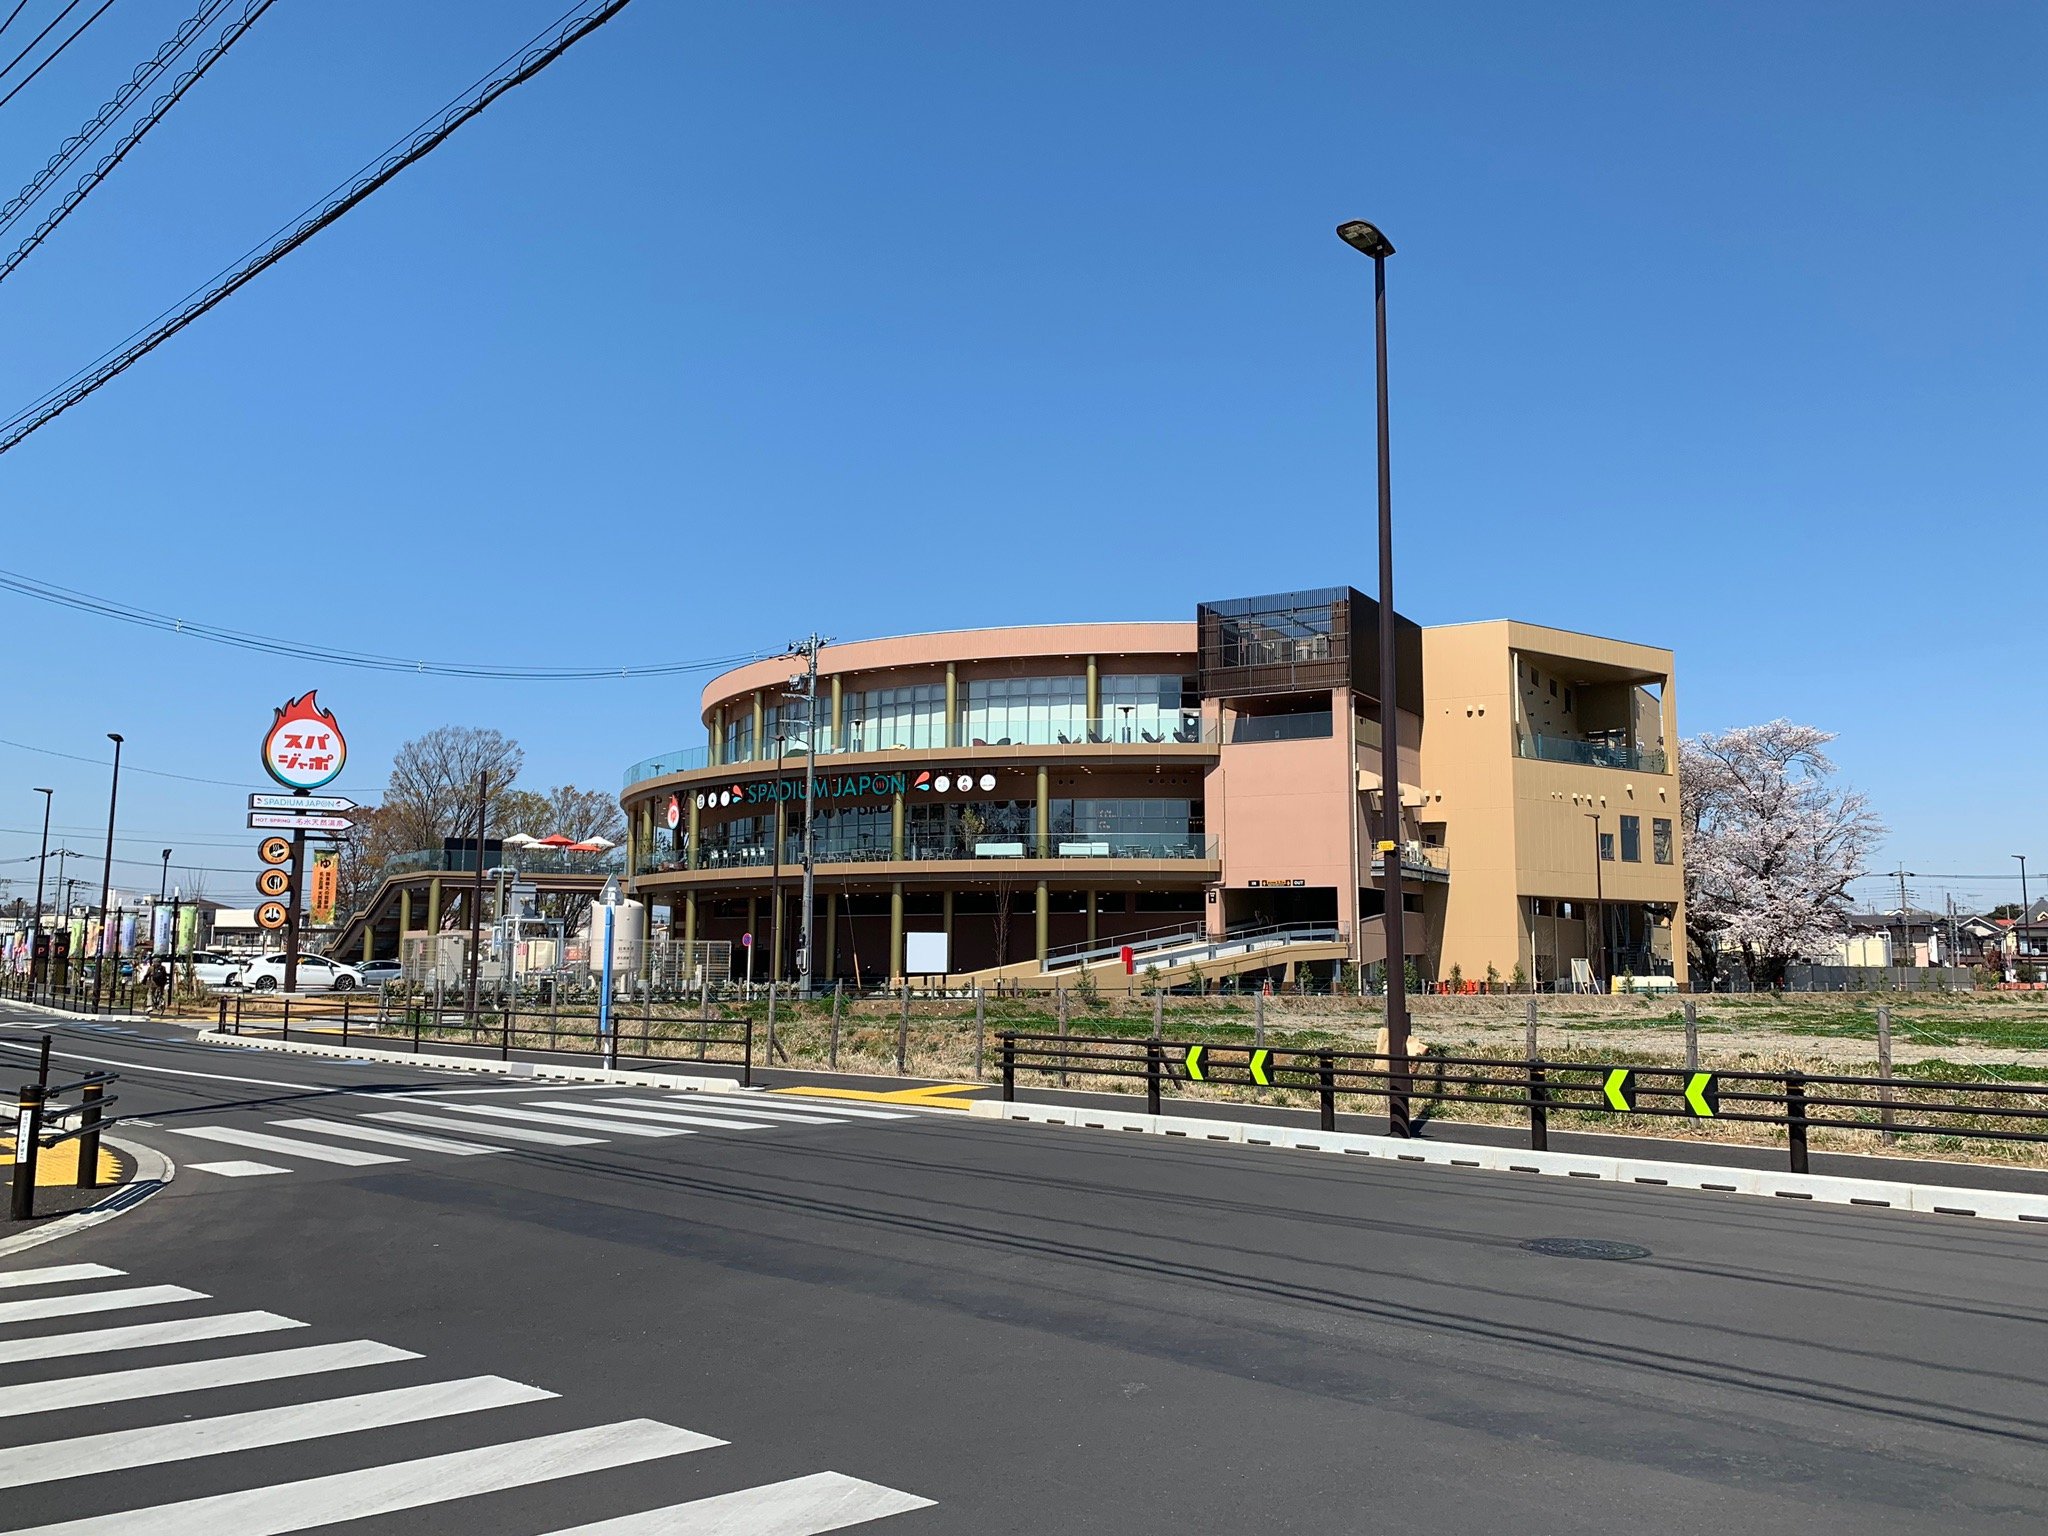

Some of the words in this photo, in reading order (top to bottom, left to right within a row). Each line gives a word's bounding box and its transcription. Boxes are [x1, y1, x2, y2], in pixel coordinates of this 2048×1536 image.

[284, 733, 330, 750] スパ
[278, 753, 334, 771] ジャポ
[747, 777, 829, 804] SPADIUM
[832, 774, 905, 798] JAPON
[264, 798, 303, 807] SPADIUM
[305, 799, 335, 808] JAPON
[320, 859, 331, 868] ゆ
[57, 946, 64, 954] P
